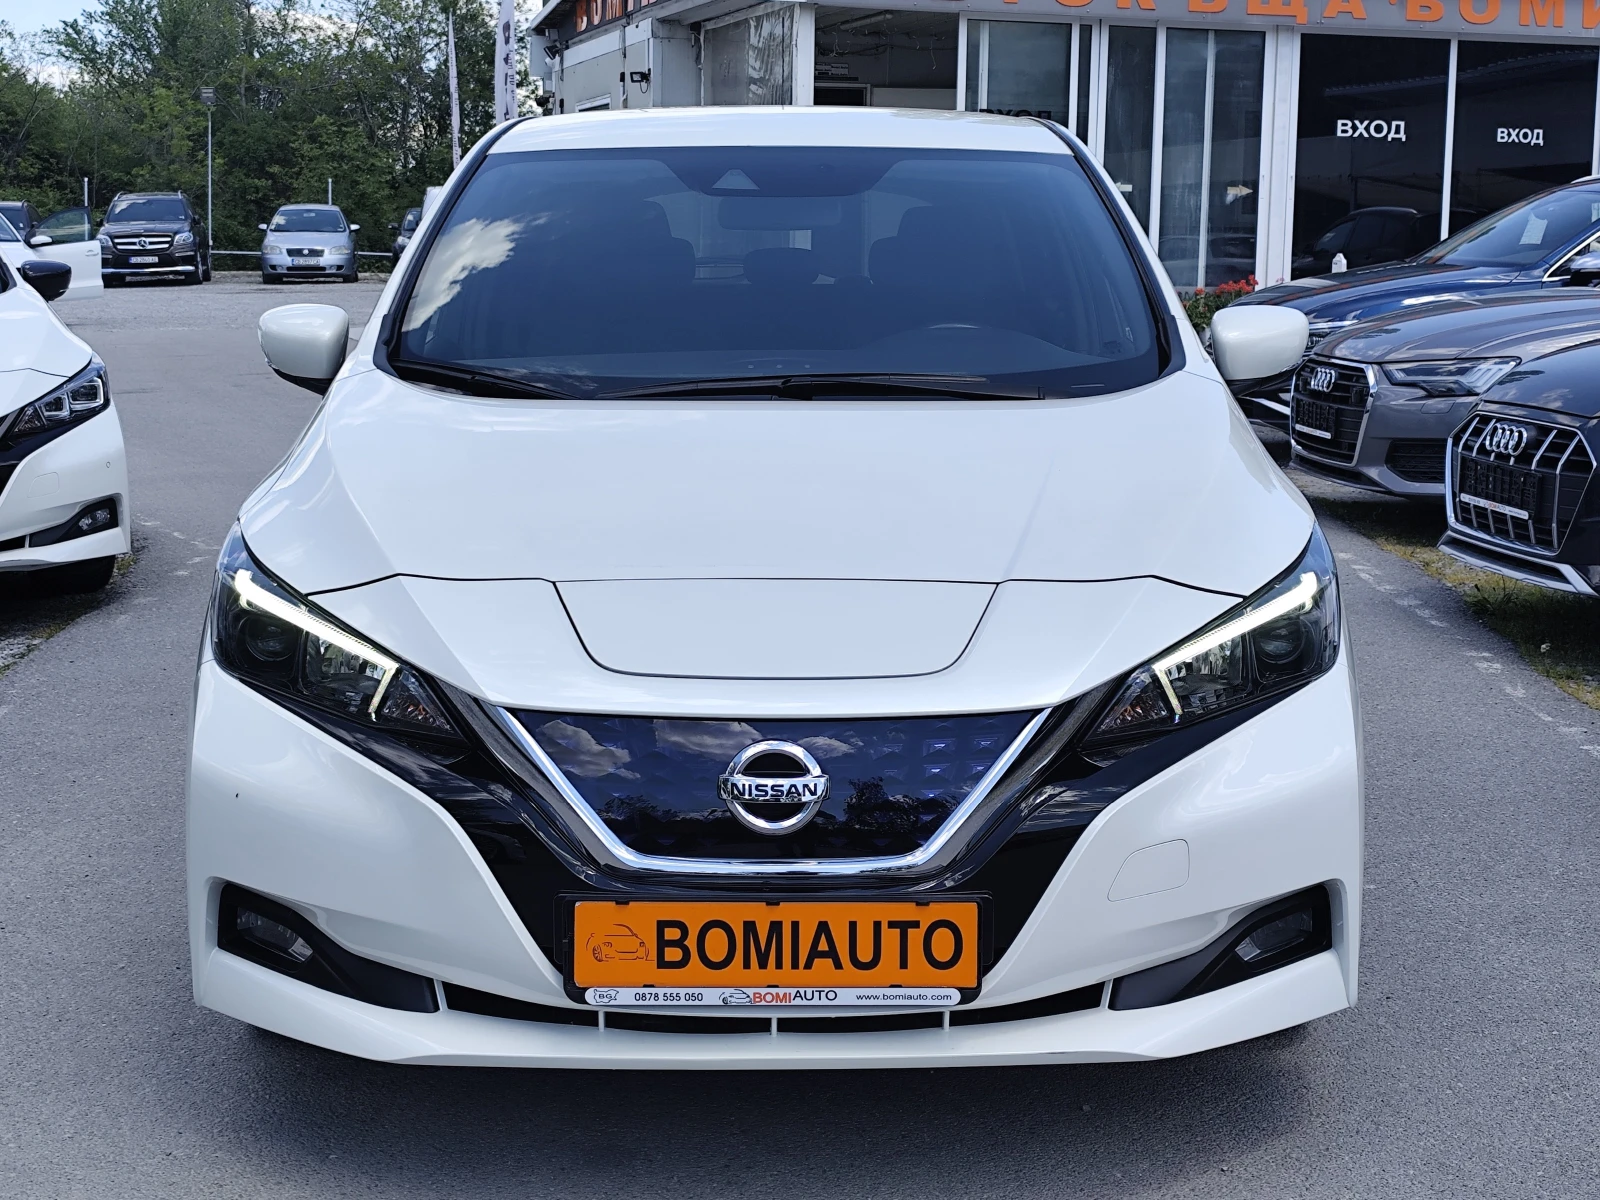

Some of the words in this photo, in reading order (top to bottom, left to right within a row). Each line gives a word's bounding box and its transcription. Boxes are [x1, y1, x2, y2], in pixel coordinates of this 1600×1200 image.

[1336, 119, 1406, 142] ВХОД
[1496, 127, 1544, 147] ВХОД
[730, 782, 818, 798] NISSAN
[655, 919, 964, 971] BOMIAUTO
[634, 992, 659, 1002] 0878
[662, 992, 682, 1002] 555
[684, 992, 704, 1002] 050
[856, 993, 952, 1001] www.bomiauto.com
